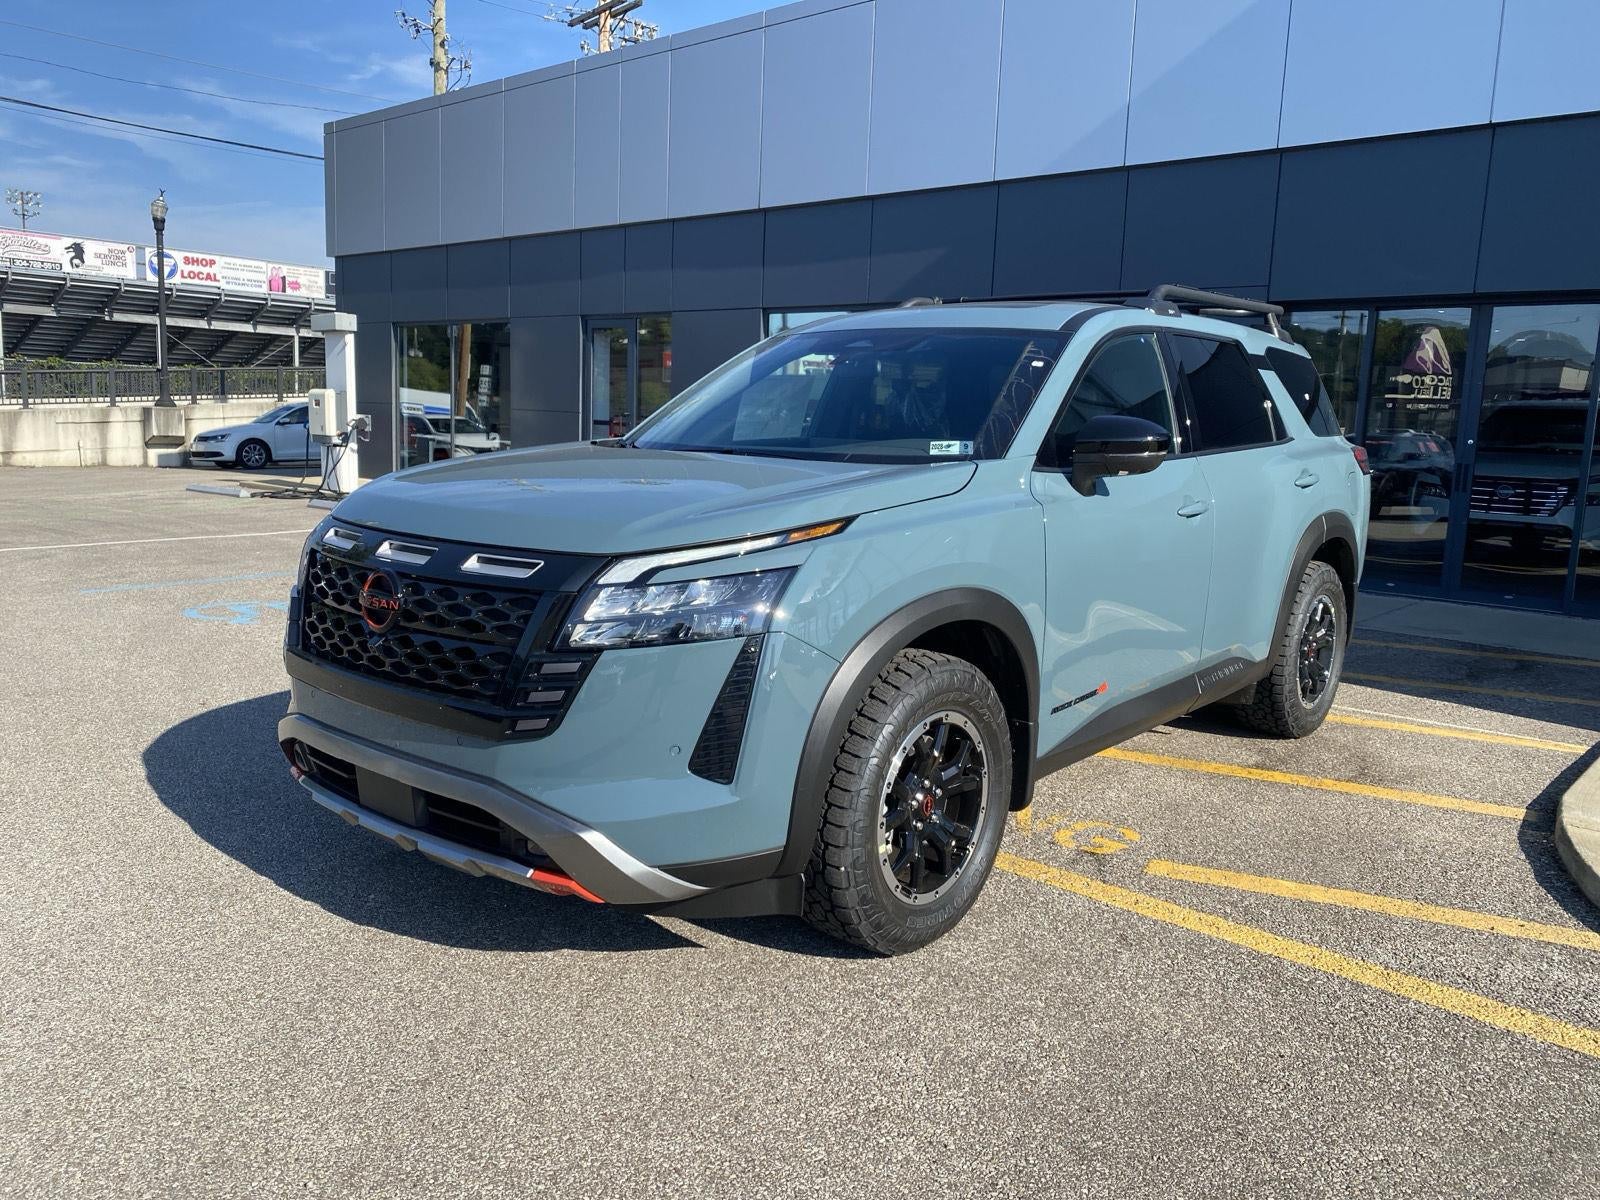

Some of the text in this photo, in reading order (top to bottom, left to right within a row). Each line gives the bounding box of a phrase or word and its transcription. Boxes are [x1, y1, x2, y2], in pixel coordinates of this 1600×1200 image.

[94, 252, 127, 261] SERVING
[183, 255, 216, 268] SHOP
[101, 259, 127, 268] LUNCH
[181, 269, 220, 282] LOCAL
